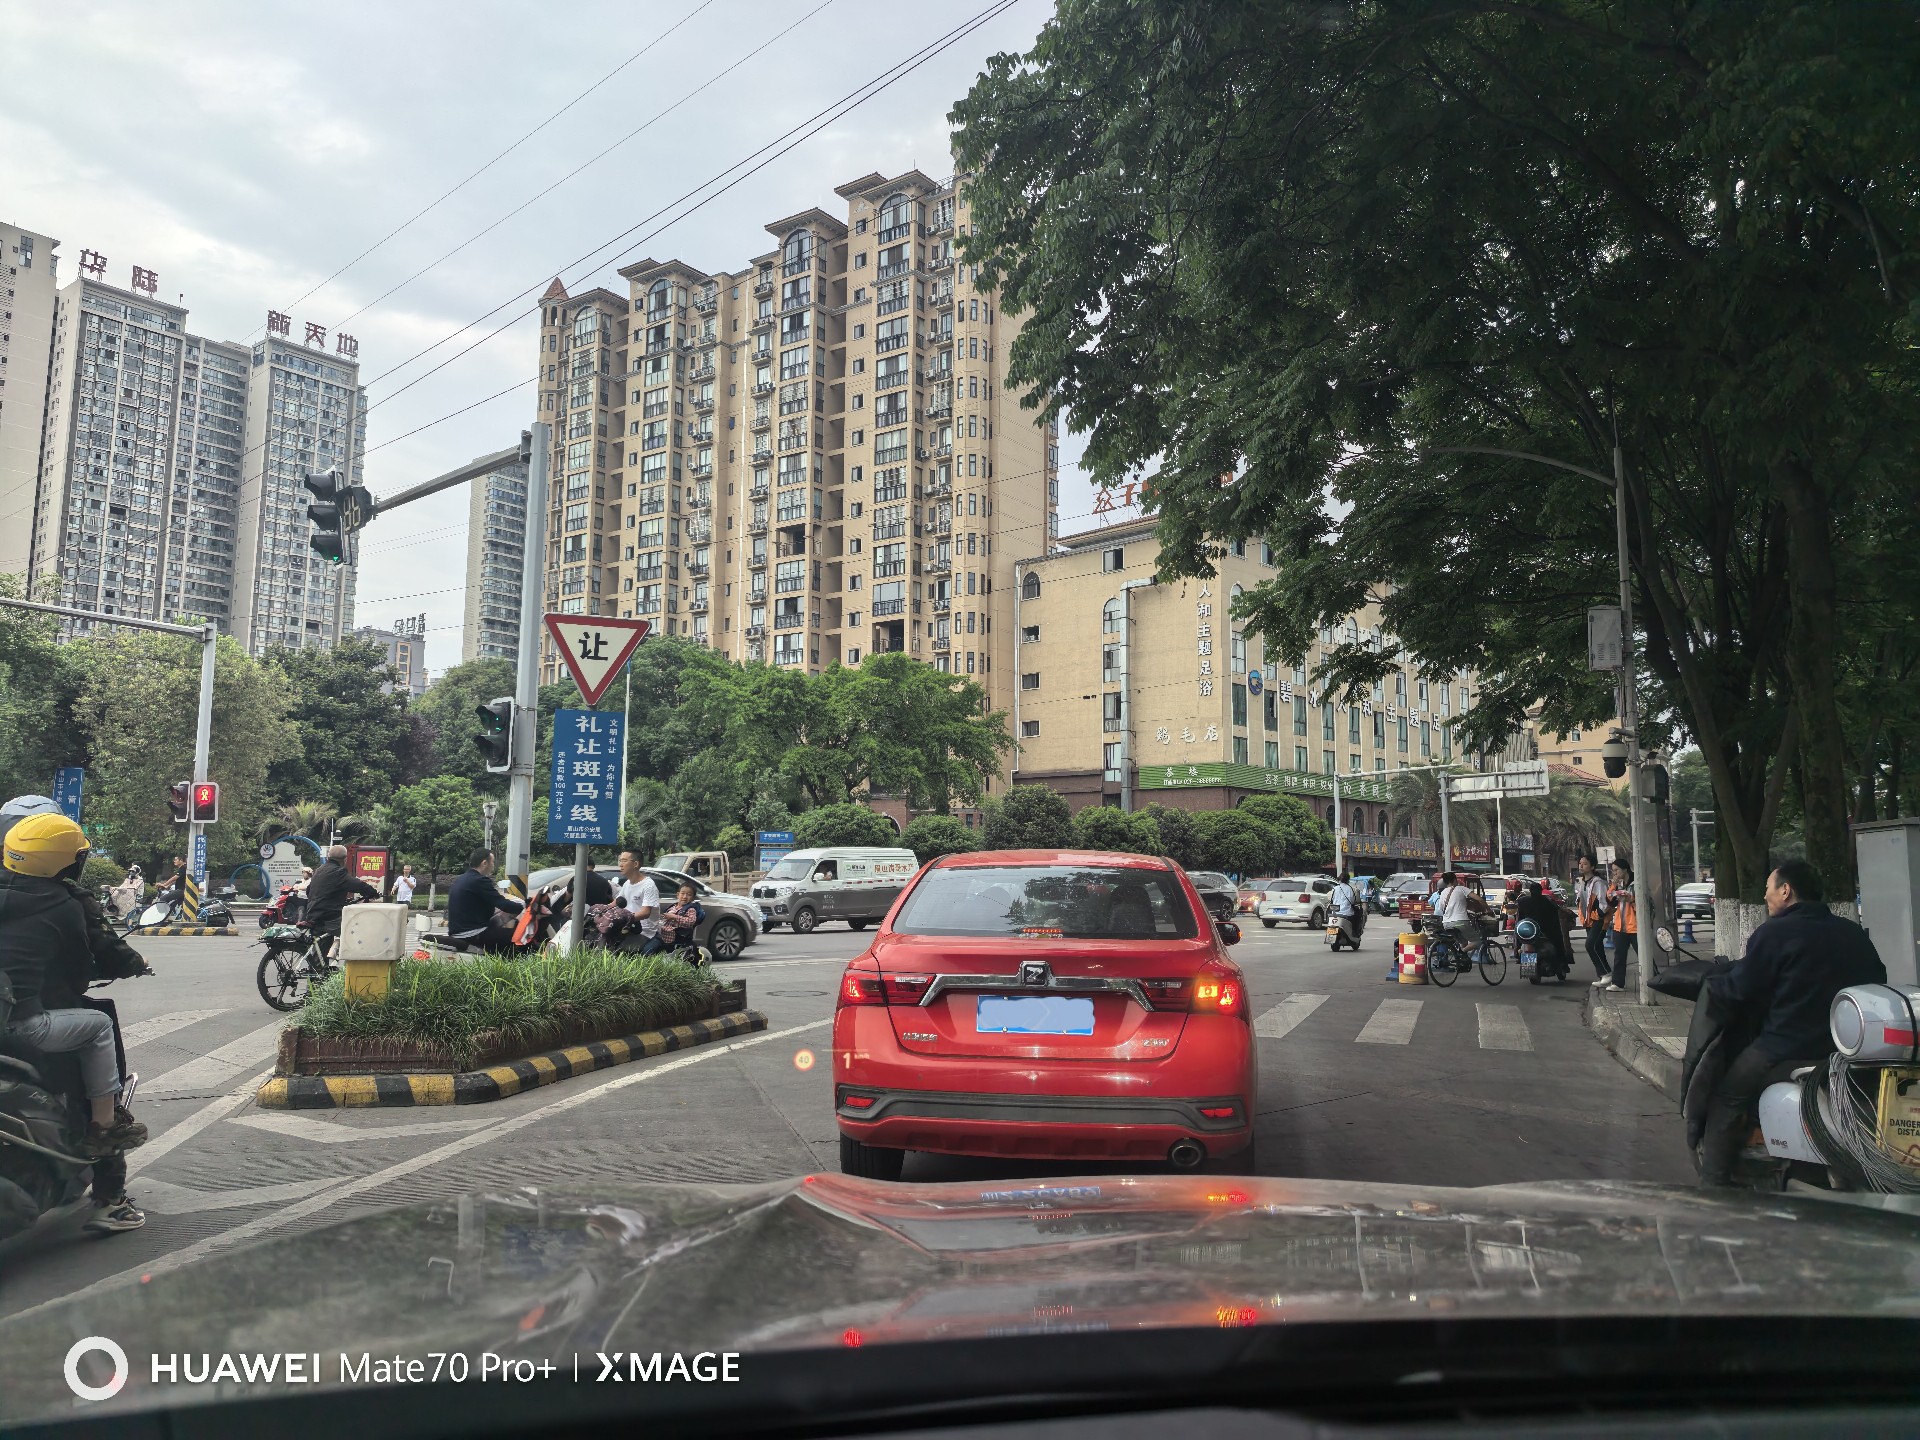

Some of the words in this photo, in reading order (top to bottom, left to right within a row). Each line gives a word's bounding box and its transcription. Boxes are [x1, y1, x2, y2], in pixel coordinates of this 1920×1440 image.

[267, 309, 359, 359] 新天地
[578, 631, 609, 661] 让
[1198, 582, 1214, 697] 人和主题足浴
[607, 718, 618, 755] 文明礼让
[570, 715, 603, 822] 礼让斑马线
[604, 763, 616, 800] 为你点赞
[1889, 1118, 1920, 1129] DANGER
